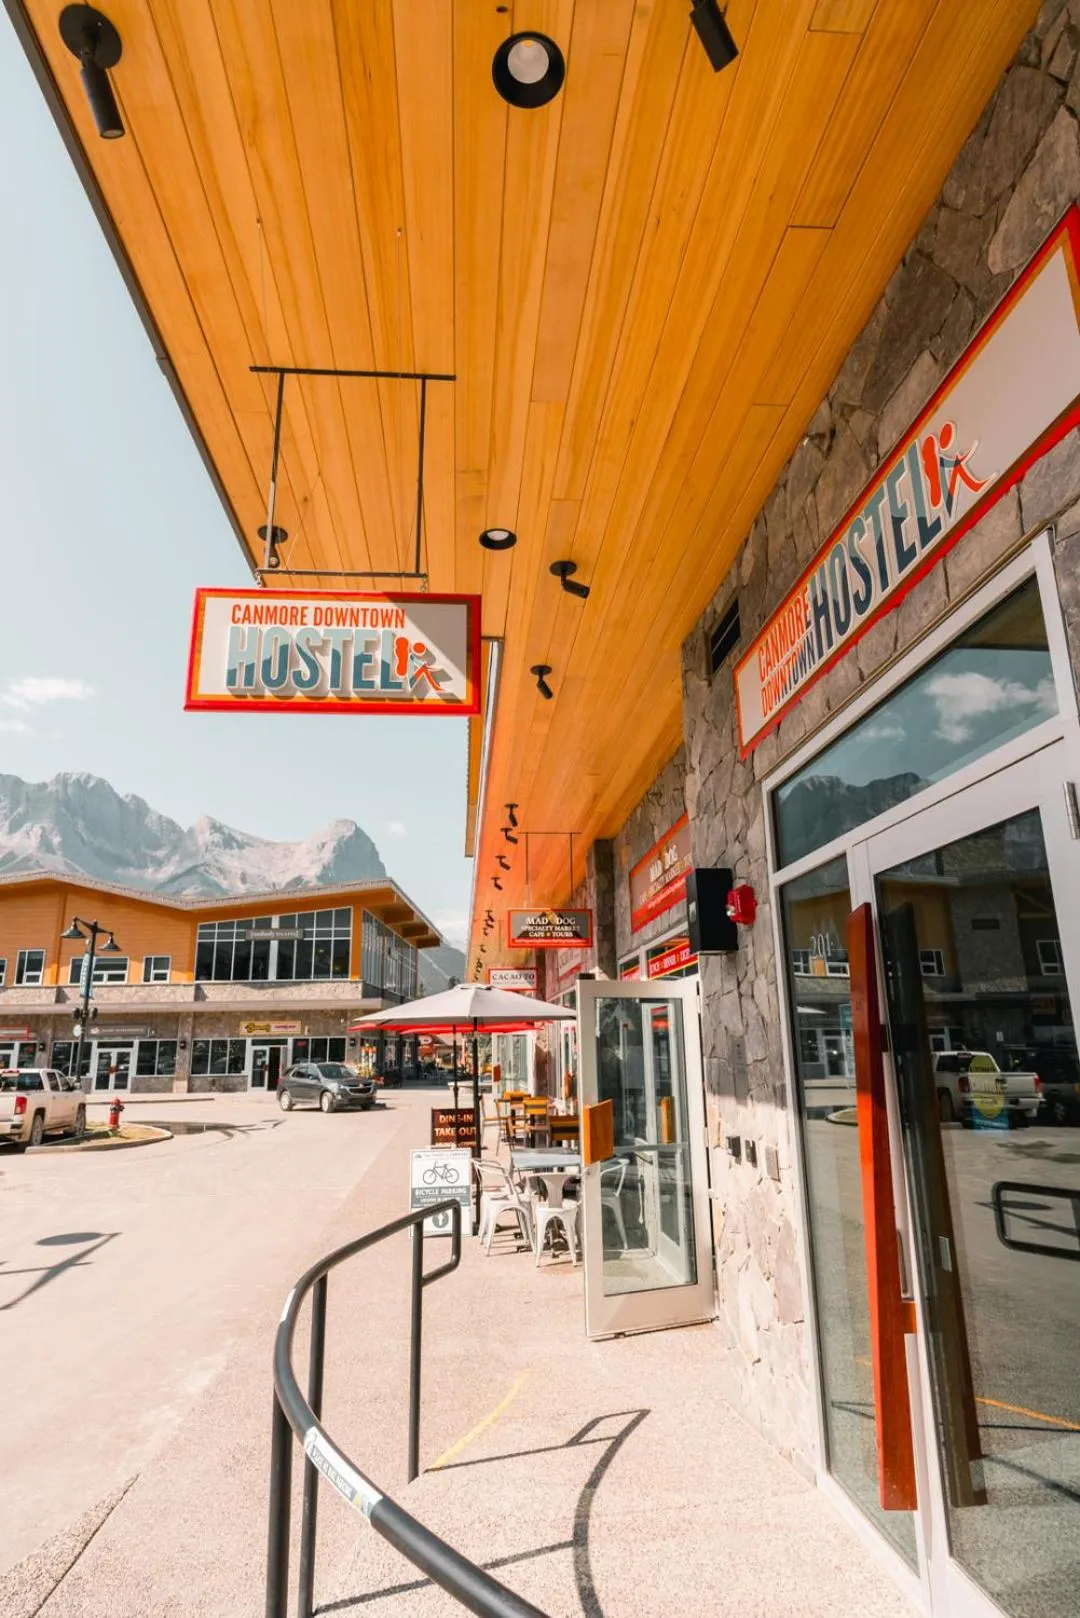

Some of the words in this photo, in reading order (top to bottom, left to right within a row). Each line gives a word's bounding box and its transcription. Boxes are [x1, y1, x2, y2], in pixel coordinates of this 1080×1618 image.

[808, 437, 942, 658] HOSTEL
[231, 604, 307, 625] CANMORE
[313, 606, 406, 628] DOWNTOWN
[759, 587, 811, 680] CANMORE
[225, 625, 405, 694] HOSTEL
[761, 630, 816, 718] DOWNTOWN
[525, 916, 548, 925] MAD
[556, 916, 576, 925] DOG
